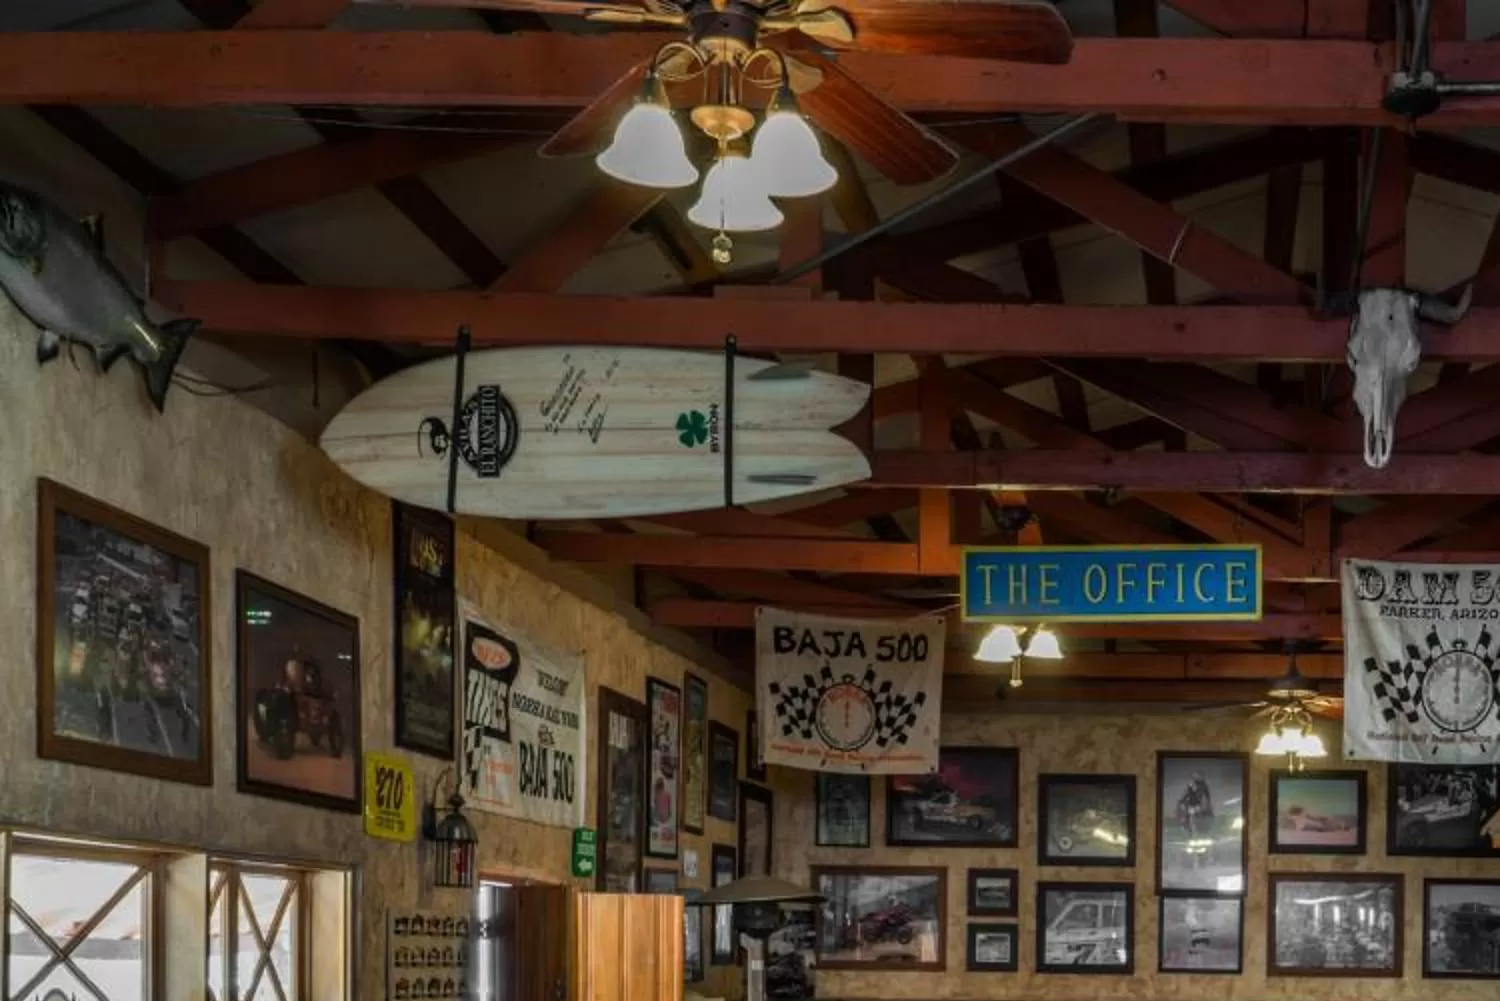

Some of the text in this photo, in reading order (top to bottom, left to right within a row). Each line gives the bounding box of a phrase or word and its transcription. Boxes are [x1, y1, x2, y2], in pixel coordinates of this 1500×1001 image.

[480, 387, 496, 474] EL RANCHITO
[710, 404, 719, 453] BYRON
[976, 561, 1250, 606] THE OFFICE
[1354, 566, 1460, 606] DAM
[1379, 605, 1445, 621] PARKER,
[773, 626, 929, 663] BAJA 500
[519, 741, 576, 804] BAJA 500
